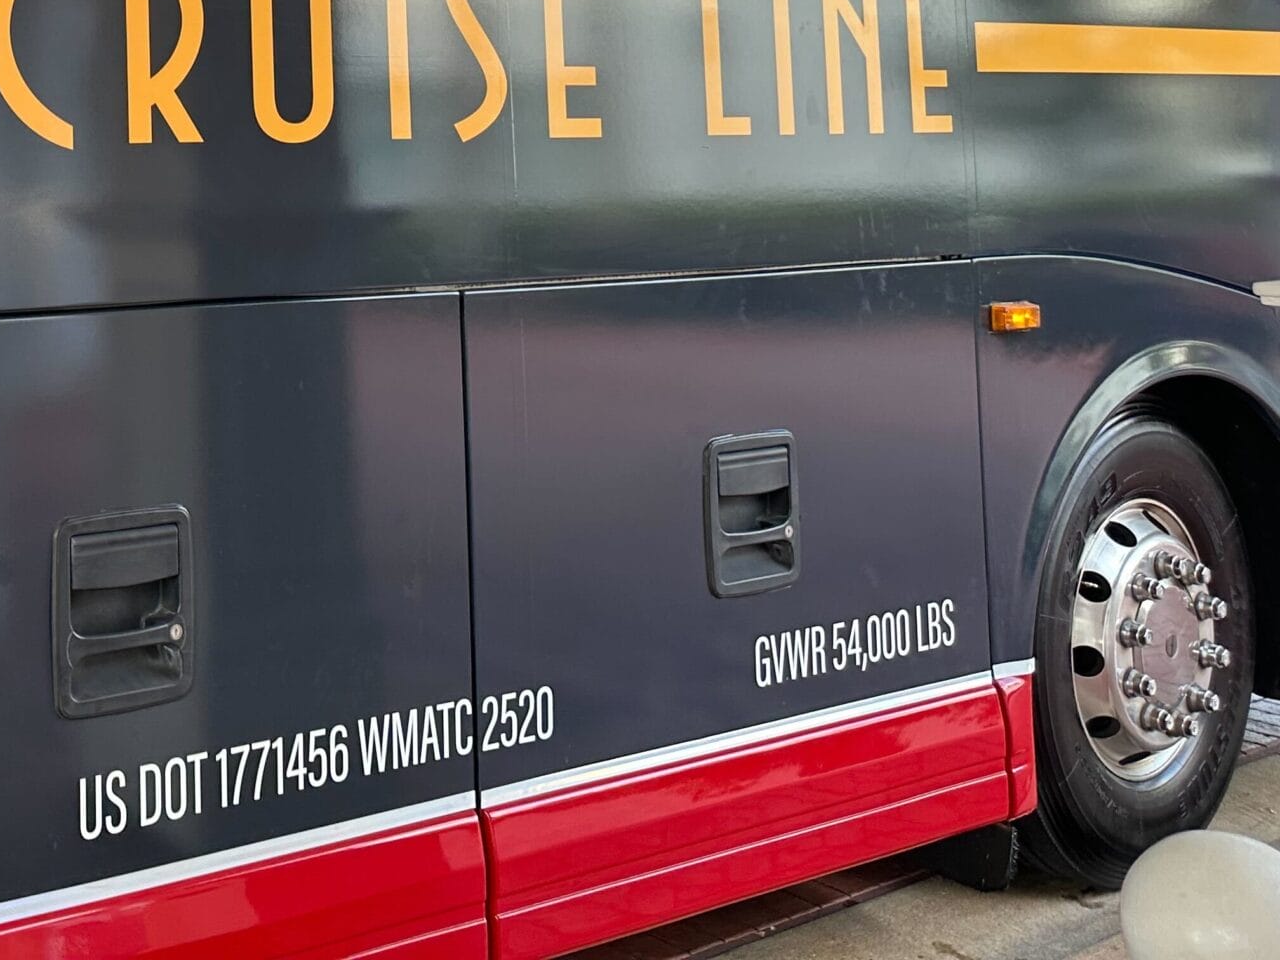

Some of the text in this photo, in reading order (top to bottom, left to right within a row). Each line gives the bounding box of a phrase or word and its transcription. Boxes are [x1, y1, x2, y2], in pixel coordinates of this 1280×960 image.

[754, 598, 956, 688] GVWR 54,000 LBS
[78, 685, 554, 841] US DOT 1771456 WMATC 2520
